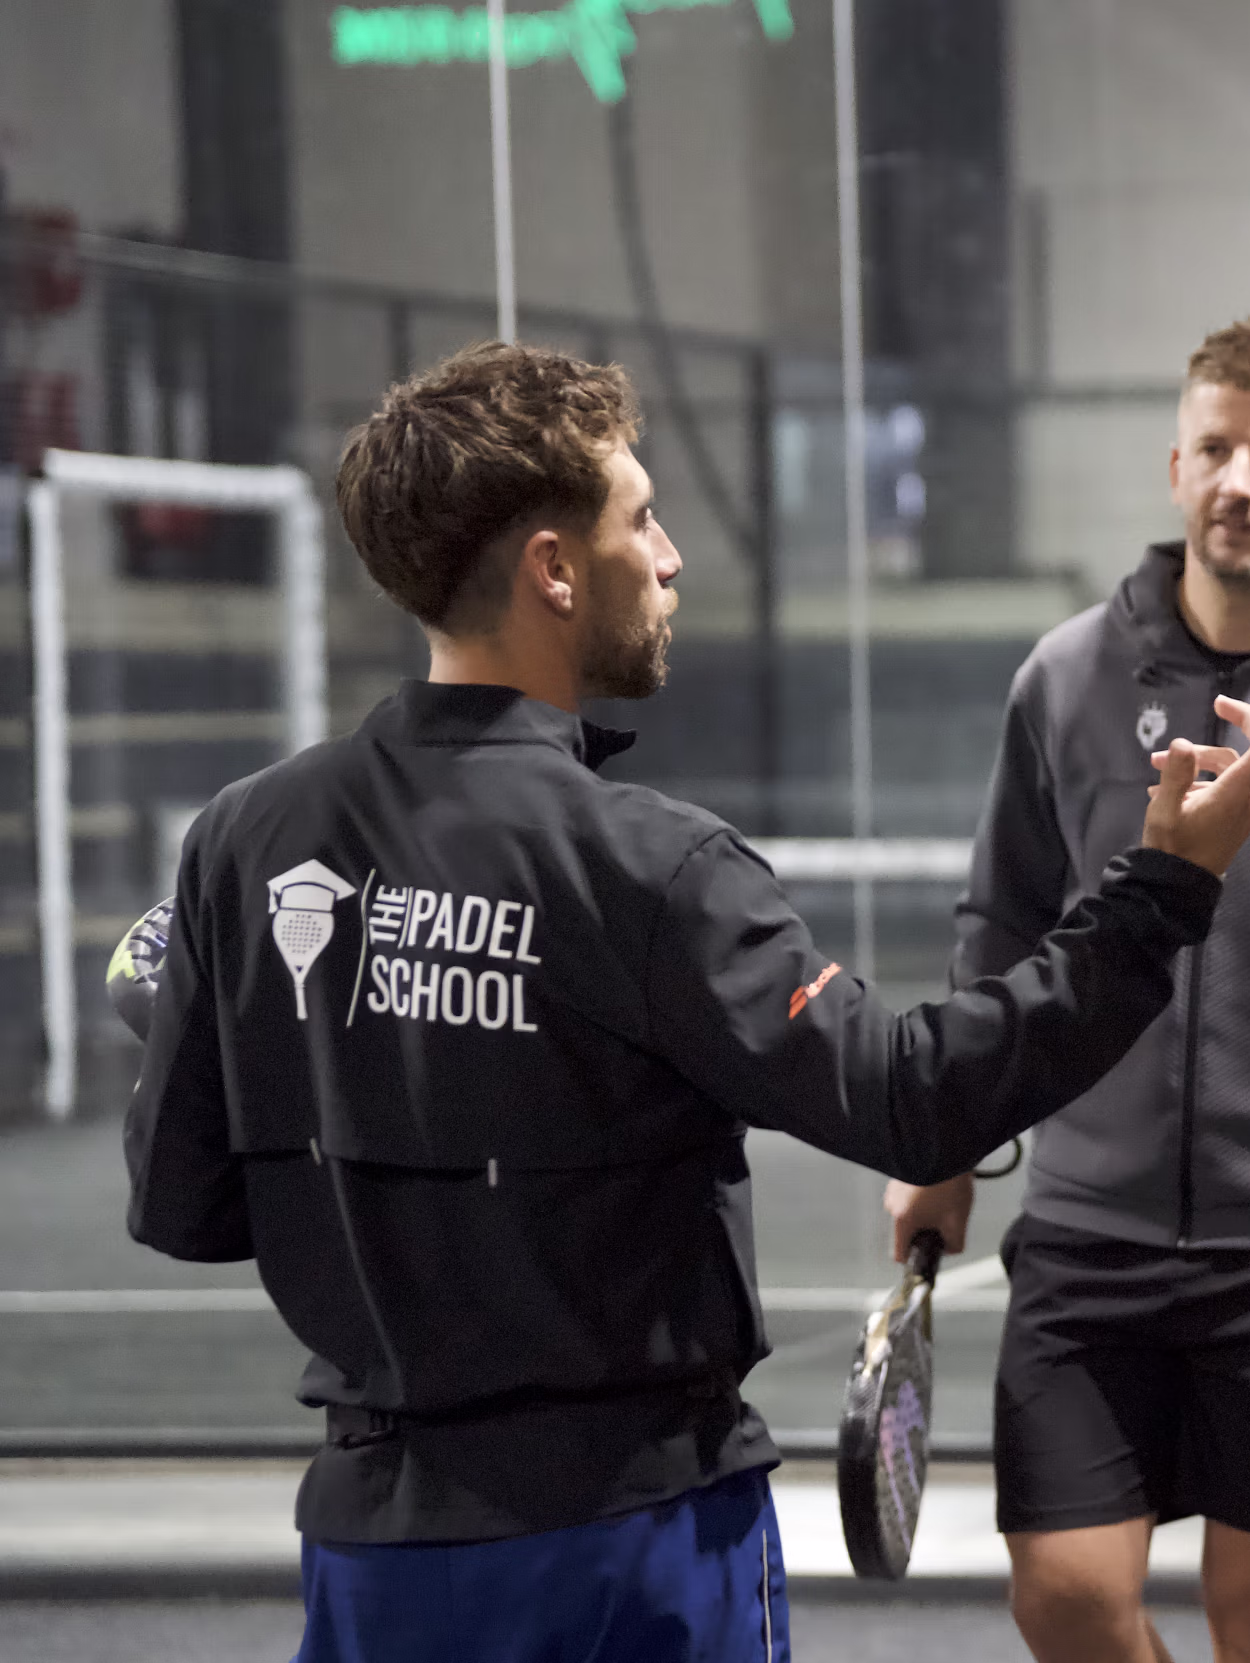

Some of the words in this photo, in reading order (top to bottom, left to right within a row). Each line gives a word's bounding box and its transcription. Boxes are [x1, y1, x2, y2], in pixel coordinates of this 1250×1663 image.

[368, 884, 409, 944] THE
[407, 888, 542, 965] PADEL
[367, 954, 539, 1032] SCHOOL
